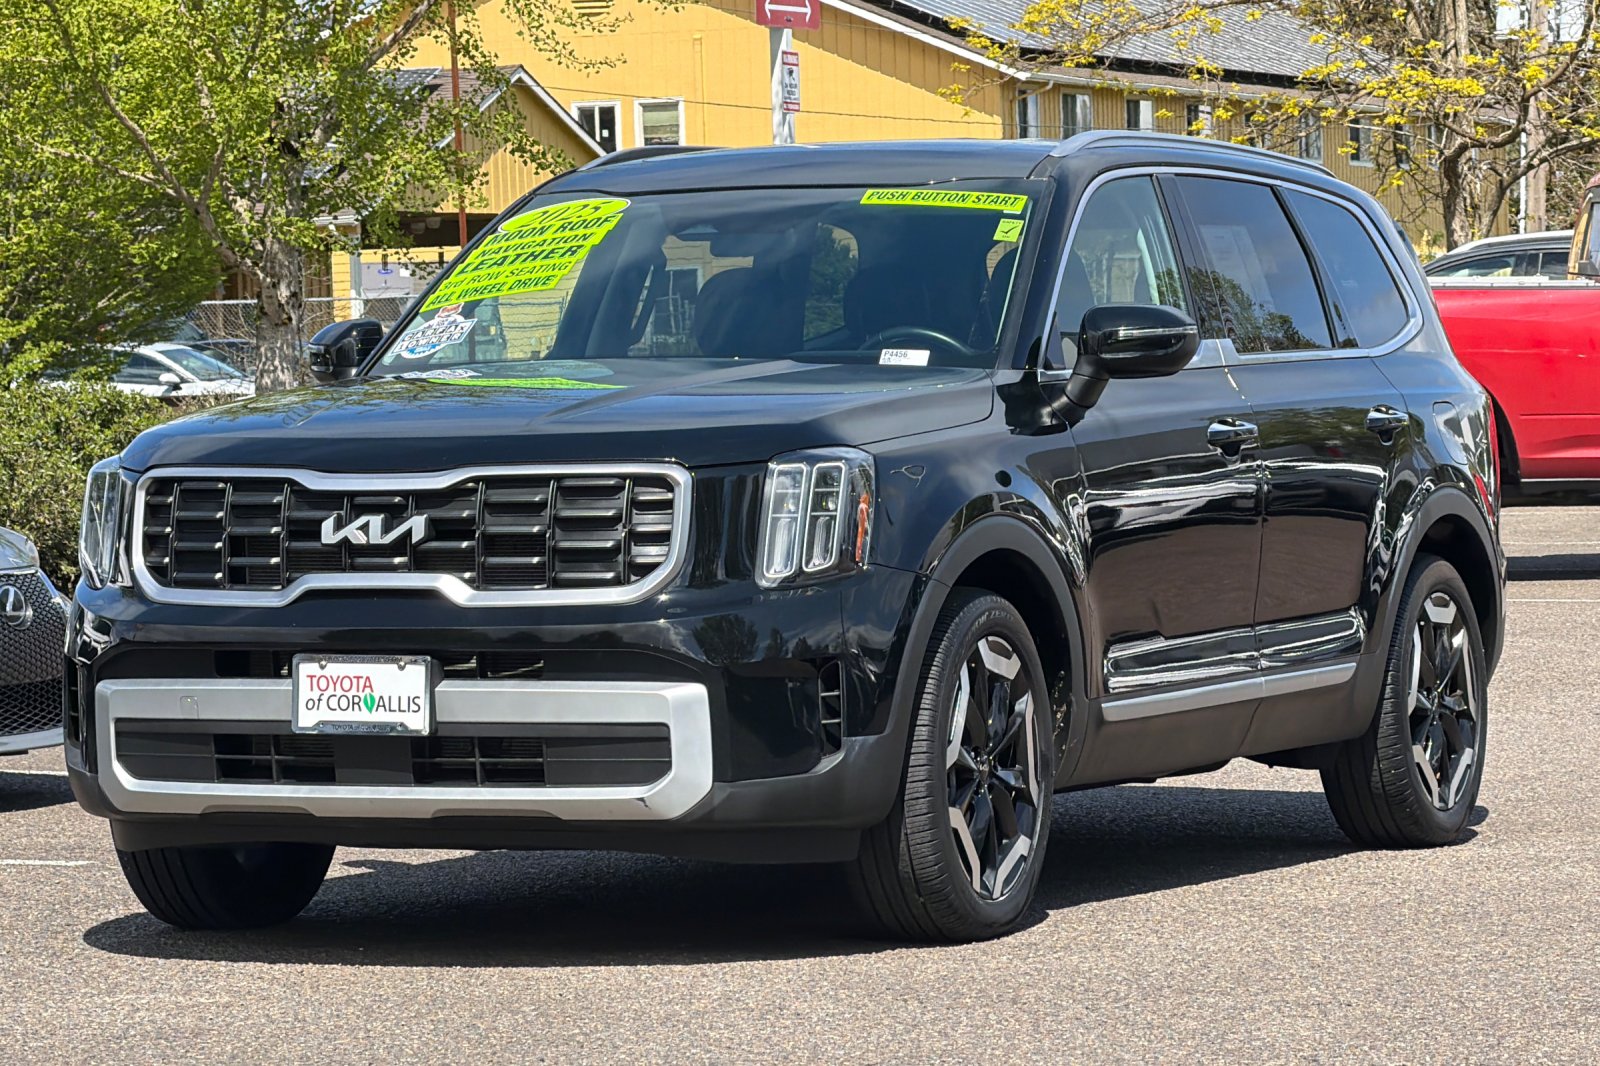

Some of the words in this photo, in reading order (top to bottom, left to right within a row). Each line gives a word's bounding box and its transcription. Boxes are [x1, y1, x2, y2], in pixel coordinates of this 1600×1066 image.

[867, 190, 909, 202] PUSH
[910, 191, 971, 203] BUTTON
[971, 195, 1022, 207] START
[518, 201, 613, 228] 2025
[486, 224, 551, 246] MOON
[553, 216, 616, 233] ROOF
[475, 232, 592, 257] NAVIGATION
[457, 245, 583, 275] LEATHER
[440, 277, 466, 292] 3rd
[466, 271, 505, 286] ROW
[506, 262, 570, 277] SEATING
[427, 291, 457, 308] ALL
[457, 282, 507, 298] WHEEL
[509, 275, 556, 290] DRIVE
[404, 324, 467, 341] CARFAX
[883, 350, 909, 358] P4456
[321, 513, 428, 544] KIA
[306, 674, 375, 693] TOYOTA
[305, 693, 324, 711] of
